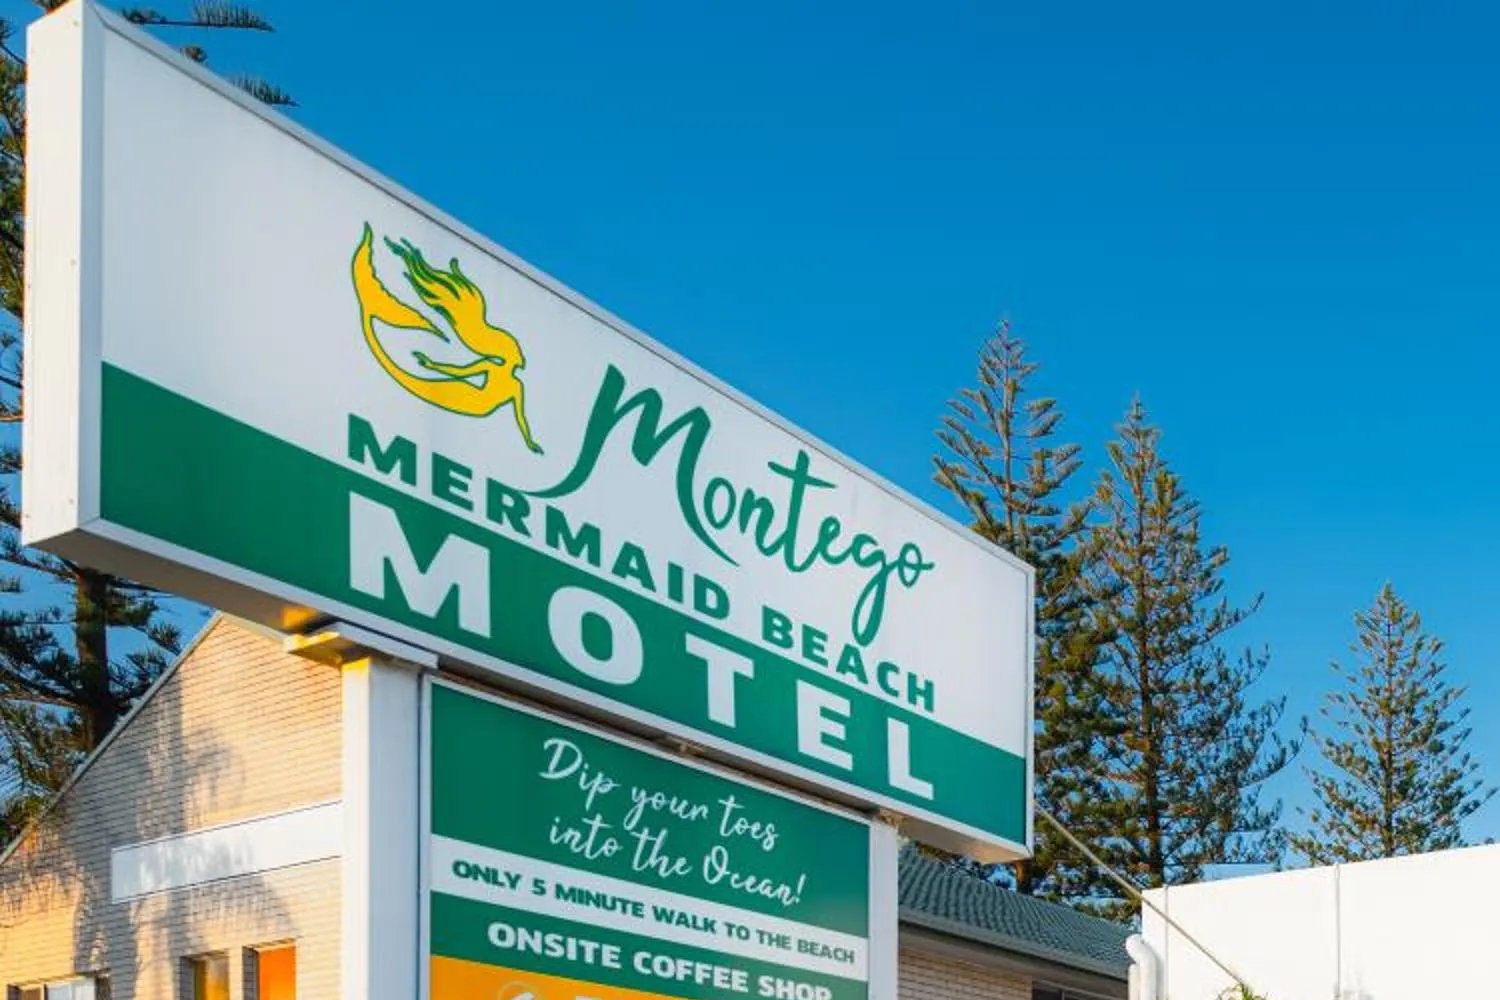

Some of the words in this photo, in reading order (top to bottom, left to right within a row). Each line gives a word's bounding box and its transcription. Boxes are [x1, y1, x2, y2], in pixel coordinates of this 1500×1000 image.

[523, 364, 935, 646] Montego
[347, 412, 731, 620] MERMAID
[761, 604, 936, 713] BEACH
[348, 490, 935, 801] MOTEL
[538, 737, 621, 811] Dip
[623, 785, 710, 831] your
[717, 794, 780, 851] toes
[452, 859, 522, 891] ONLY
[531, 877, 547, 897] 5
[555, 883, 645, 918] MINUTE
[652, 904, 717, 935] WALK
[724, 921, 750, 941] TO
[756, 929, 793, 951] THE
[797, 938, 855, 964] BEACH
[548, 813, 623, 860] into
[629, 826, 693, 878] the
[702, 844, 807, 906] Ocean!
[487, 921, 623, 969] ONSITE
[633, 950, 750, 994] COFFEE
